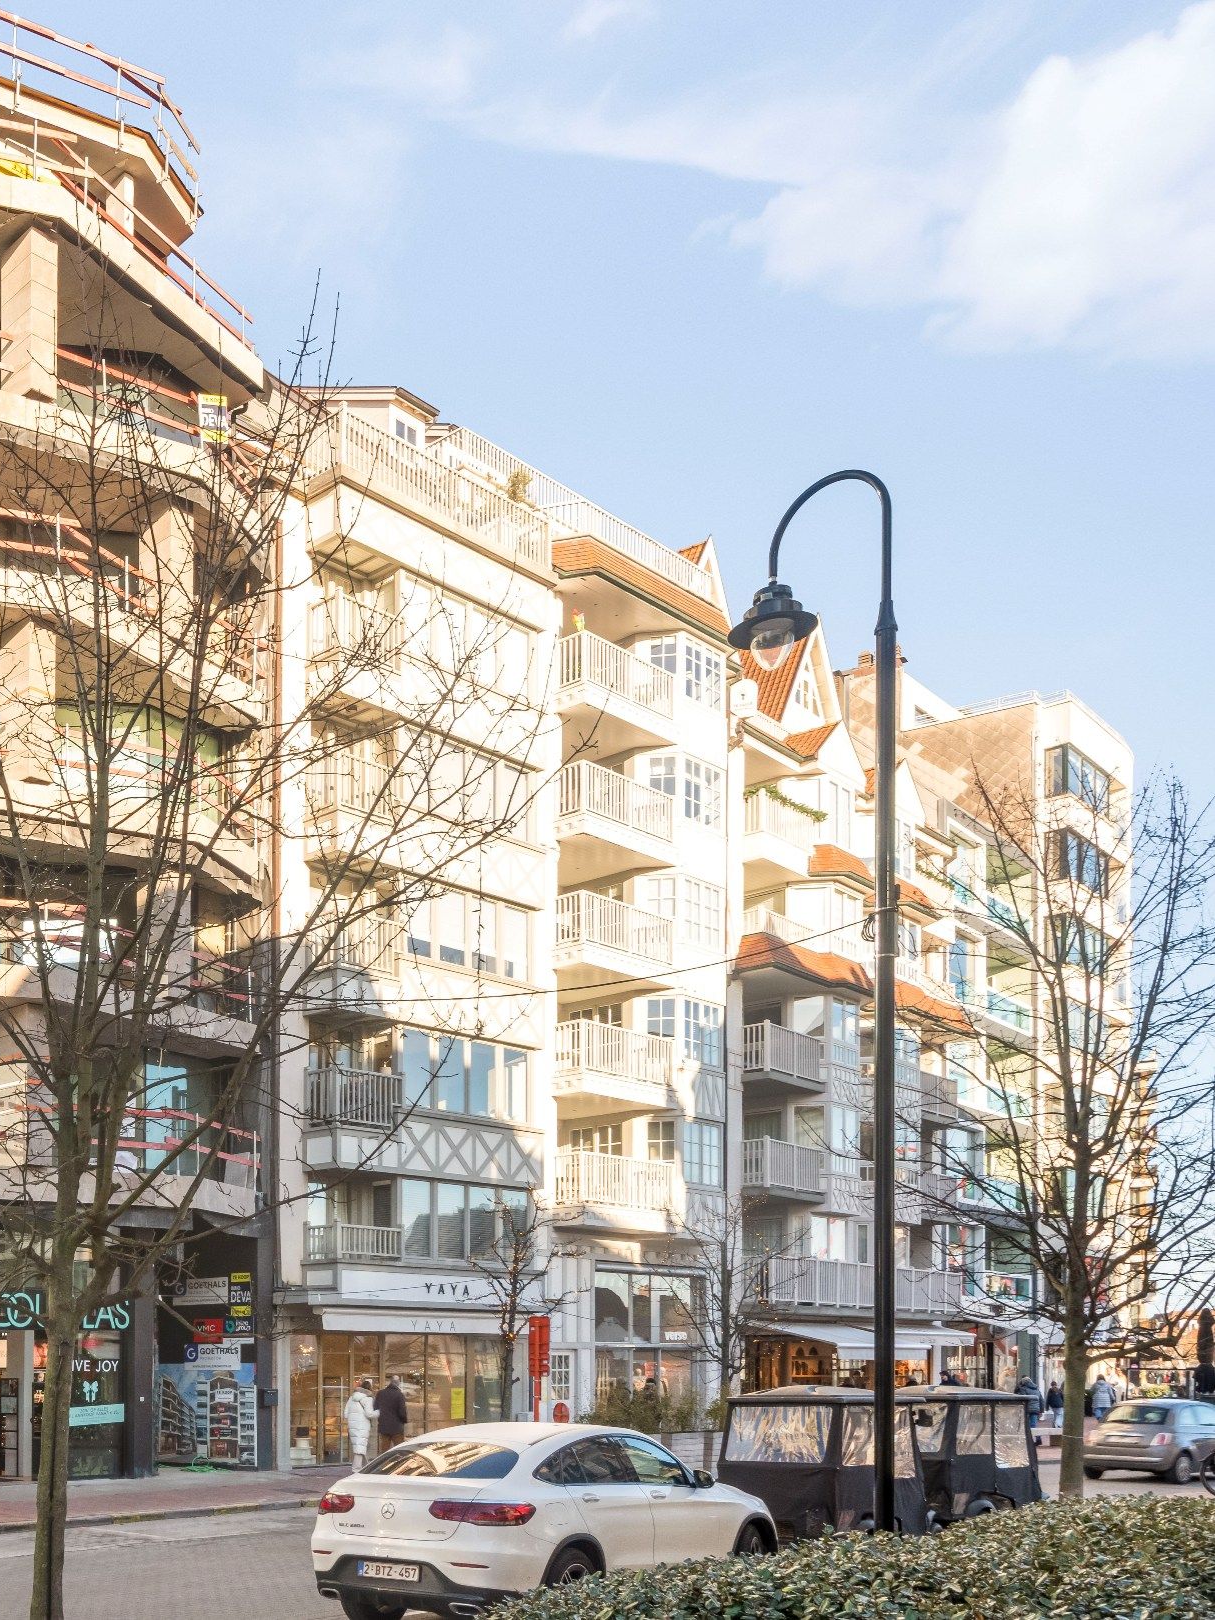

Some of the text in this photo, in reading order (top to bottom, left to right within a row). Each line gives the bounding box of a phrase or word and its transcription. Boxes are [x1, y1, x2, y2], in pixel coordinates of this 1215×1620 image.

[188, 1280, 227, 1290] GOETHALS
[425, 1282, 470, 1297] YAYA
[230, 1291, 252, 1303] DEVA
[411, 1319, 456, 1332] YAYA
[199, 1347, 239, 1355] GOETHALS
[96, 1360, 119, 1372] JOY
